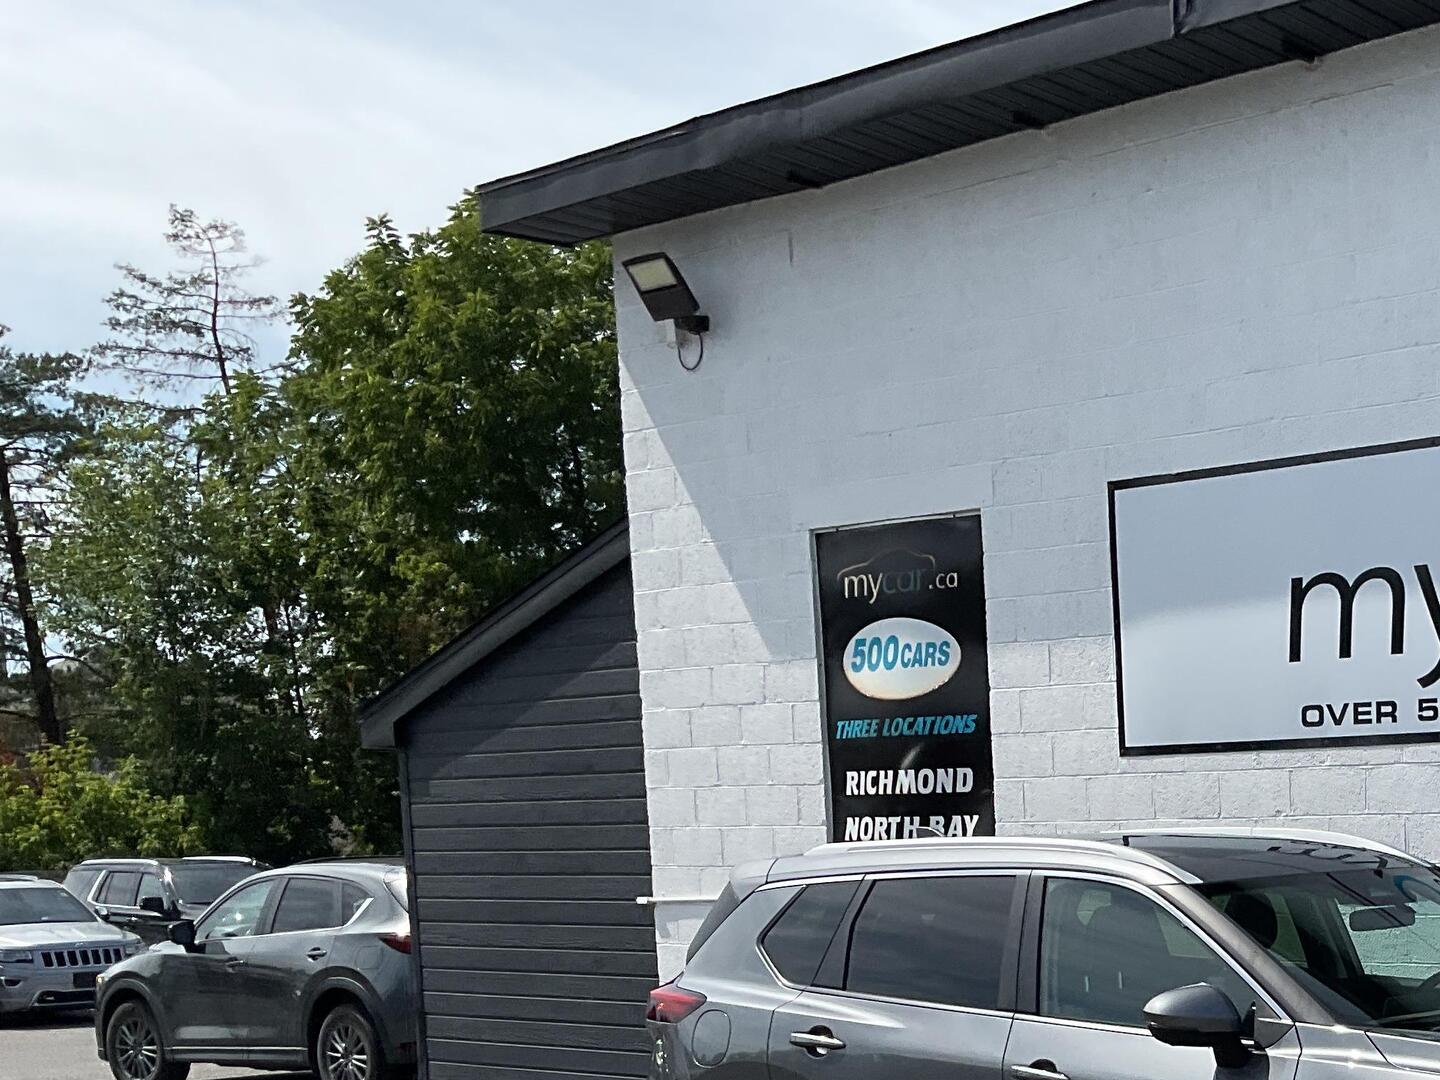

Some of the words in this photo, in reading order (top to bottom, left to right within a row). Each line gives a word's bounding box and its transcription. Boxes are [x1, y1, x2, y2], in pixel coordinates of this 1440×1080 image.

[843, 566, 958, 604] mycar.ca
[850, 634, 900, 673] 500
[900, 640, 950, 668] CARS
[835, 718, 879, 740] THREE
[882, 714, 978, 738] LOCATIONS
[1300, 700, 1399, 727] OVER
[845, 767, 974, 795] RICHMOND
[844, 815, 920, 842] NORTH
[929, 814, 980, 838] BAY
